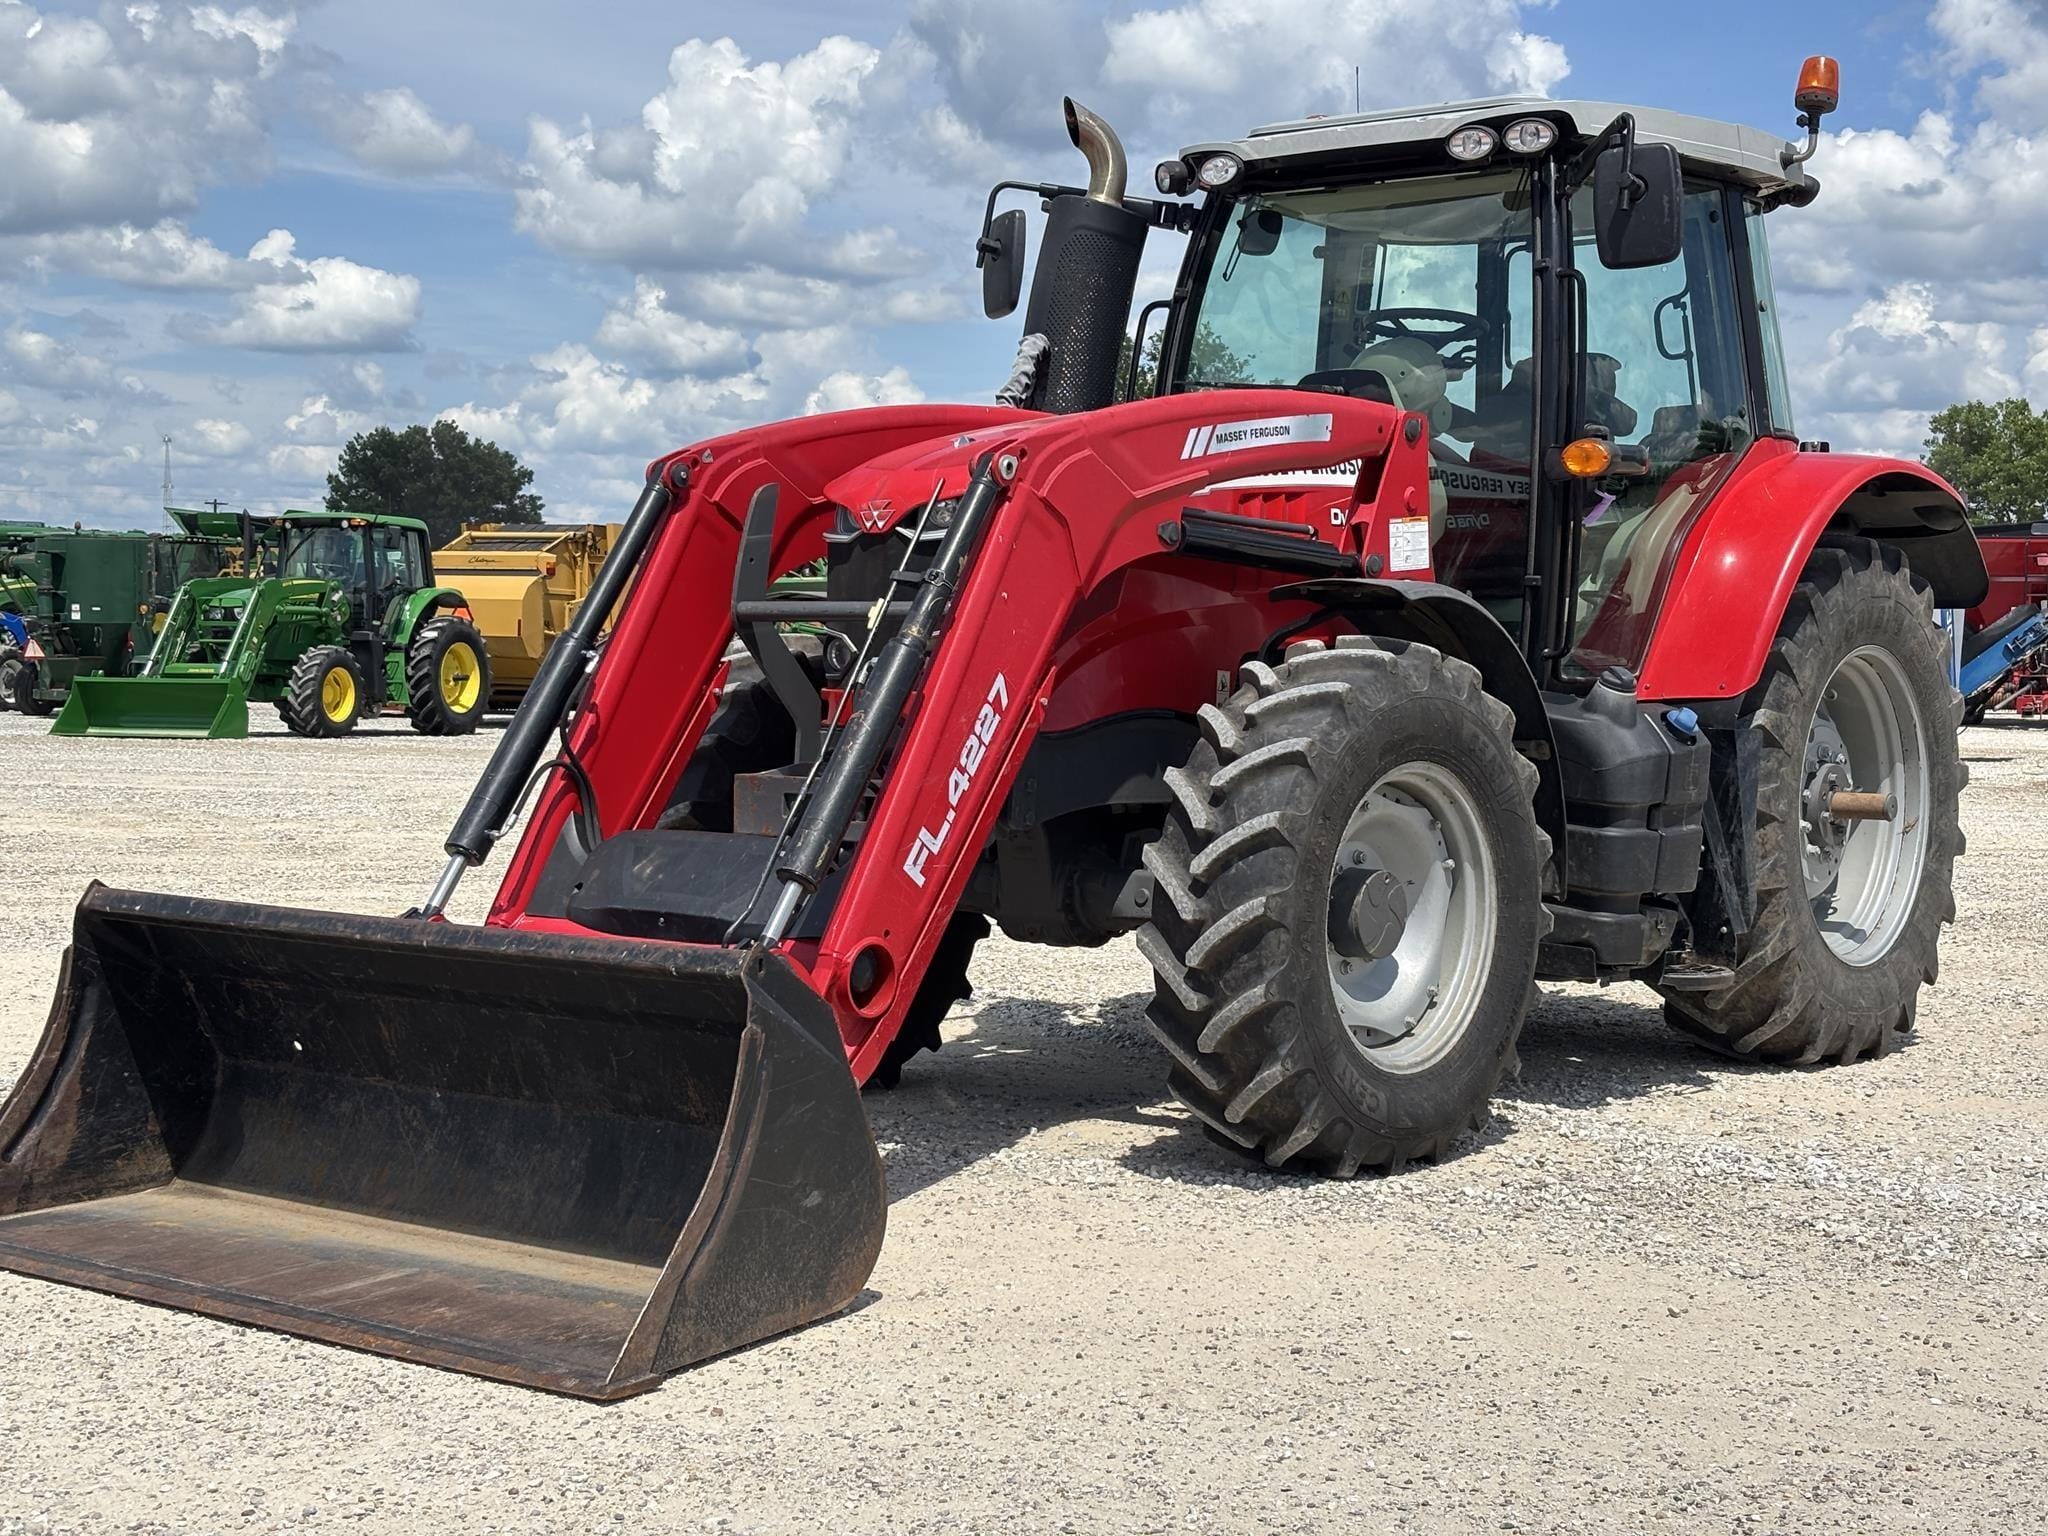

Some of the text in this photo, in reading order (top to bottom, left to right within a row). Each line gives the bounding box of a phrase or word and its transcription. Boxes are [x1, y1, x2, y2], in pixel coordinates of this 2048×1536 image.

[1216, 425, 1291, 444] MASSEY FERGUSON
[903, 672, 1008, 888] FL.4227
